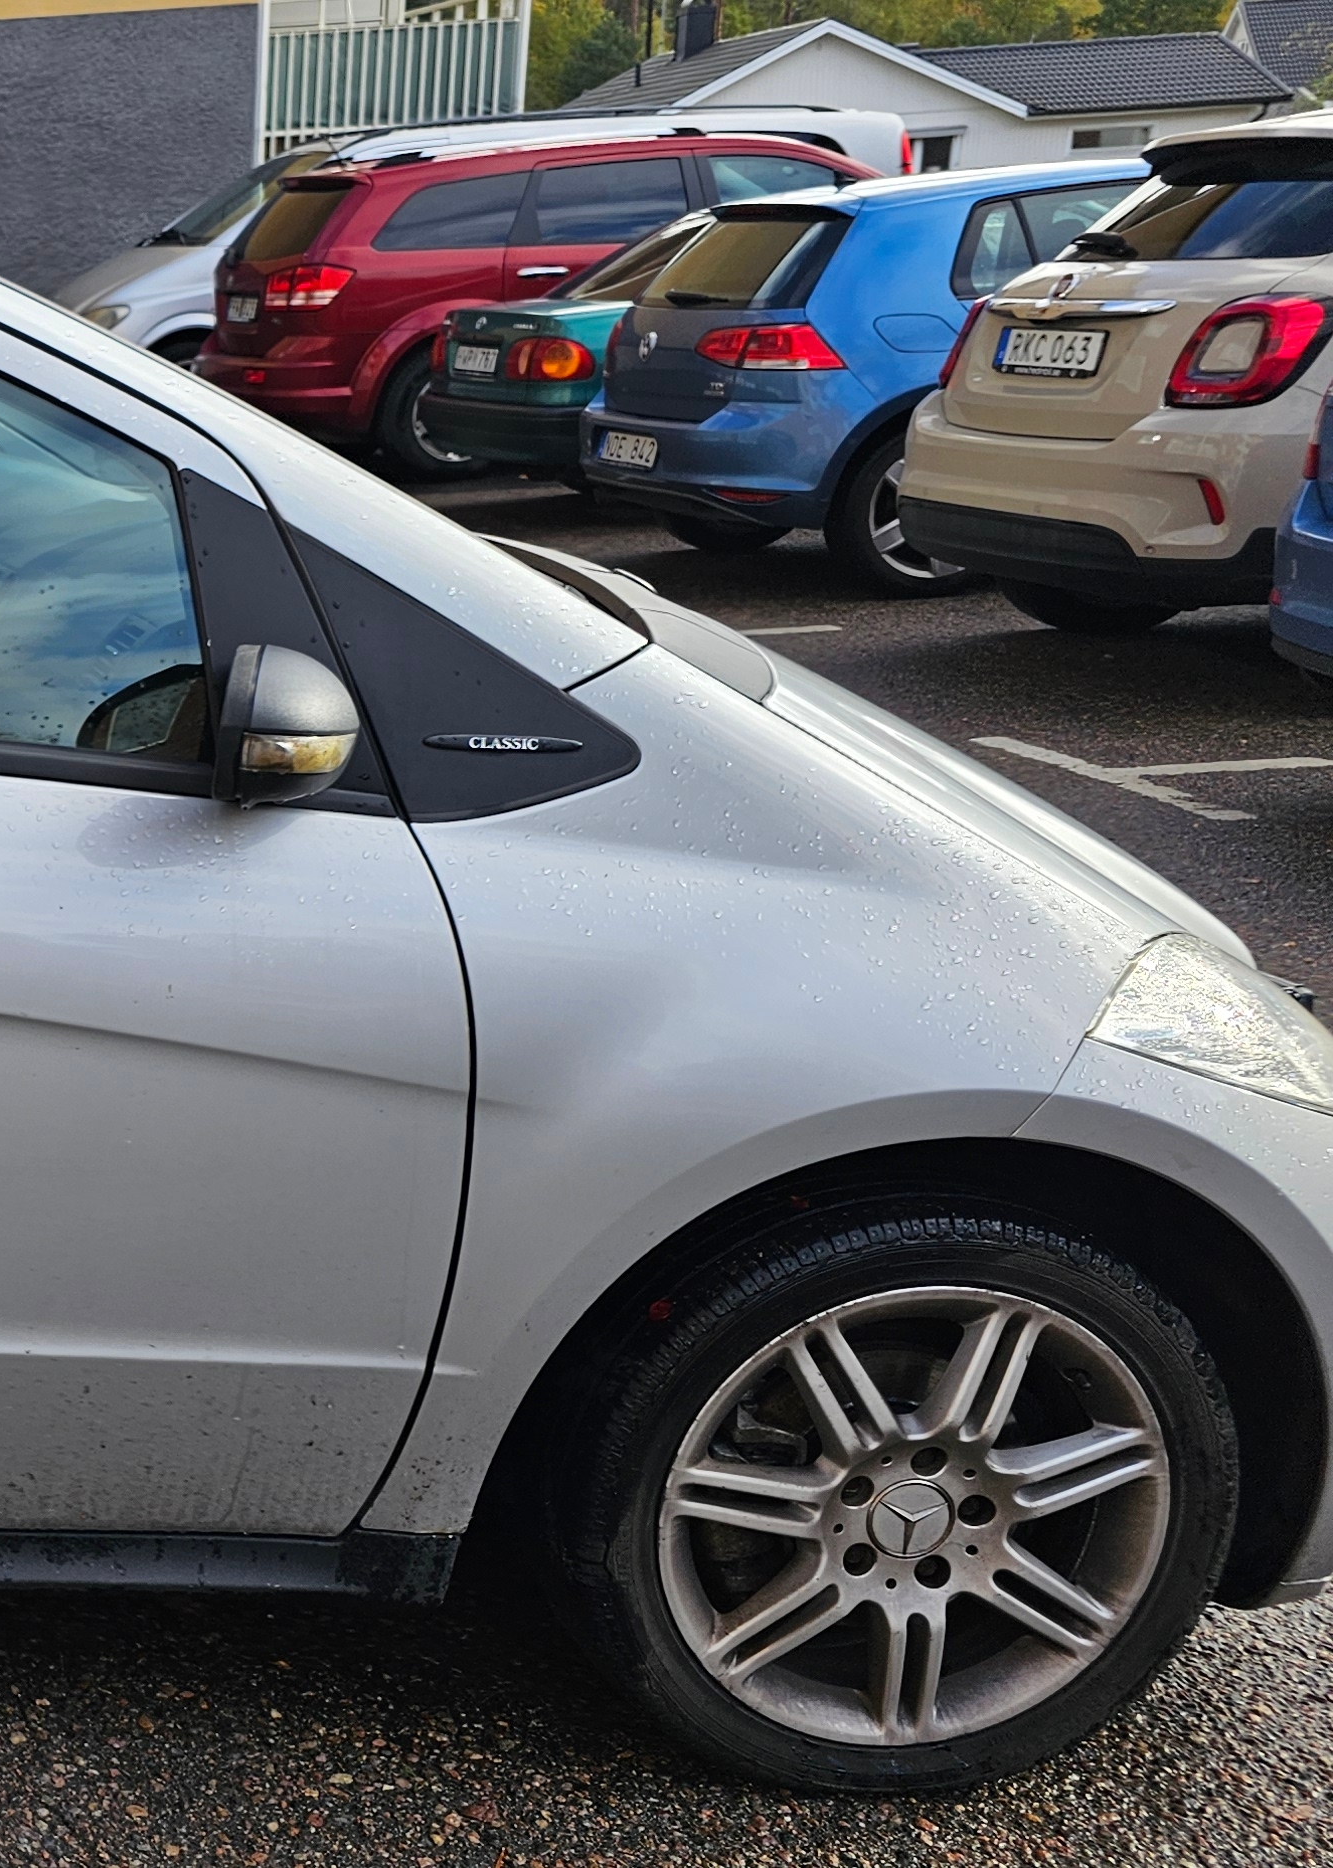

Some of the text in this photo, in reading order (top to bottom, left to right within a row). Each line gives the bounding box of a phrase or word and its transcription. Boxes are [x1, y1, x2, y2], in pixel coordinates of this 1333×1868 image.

[478, 350, 497, 369] 767
[1008, 332, 1092, 365] RKC 063
[606, 434, 656, 463] NDE 842
[468, 736, 539, 750] CLASSIC
